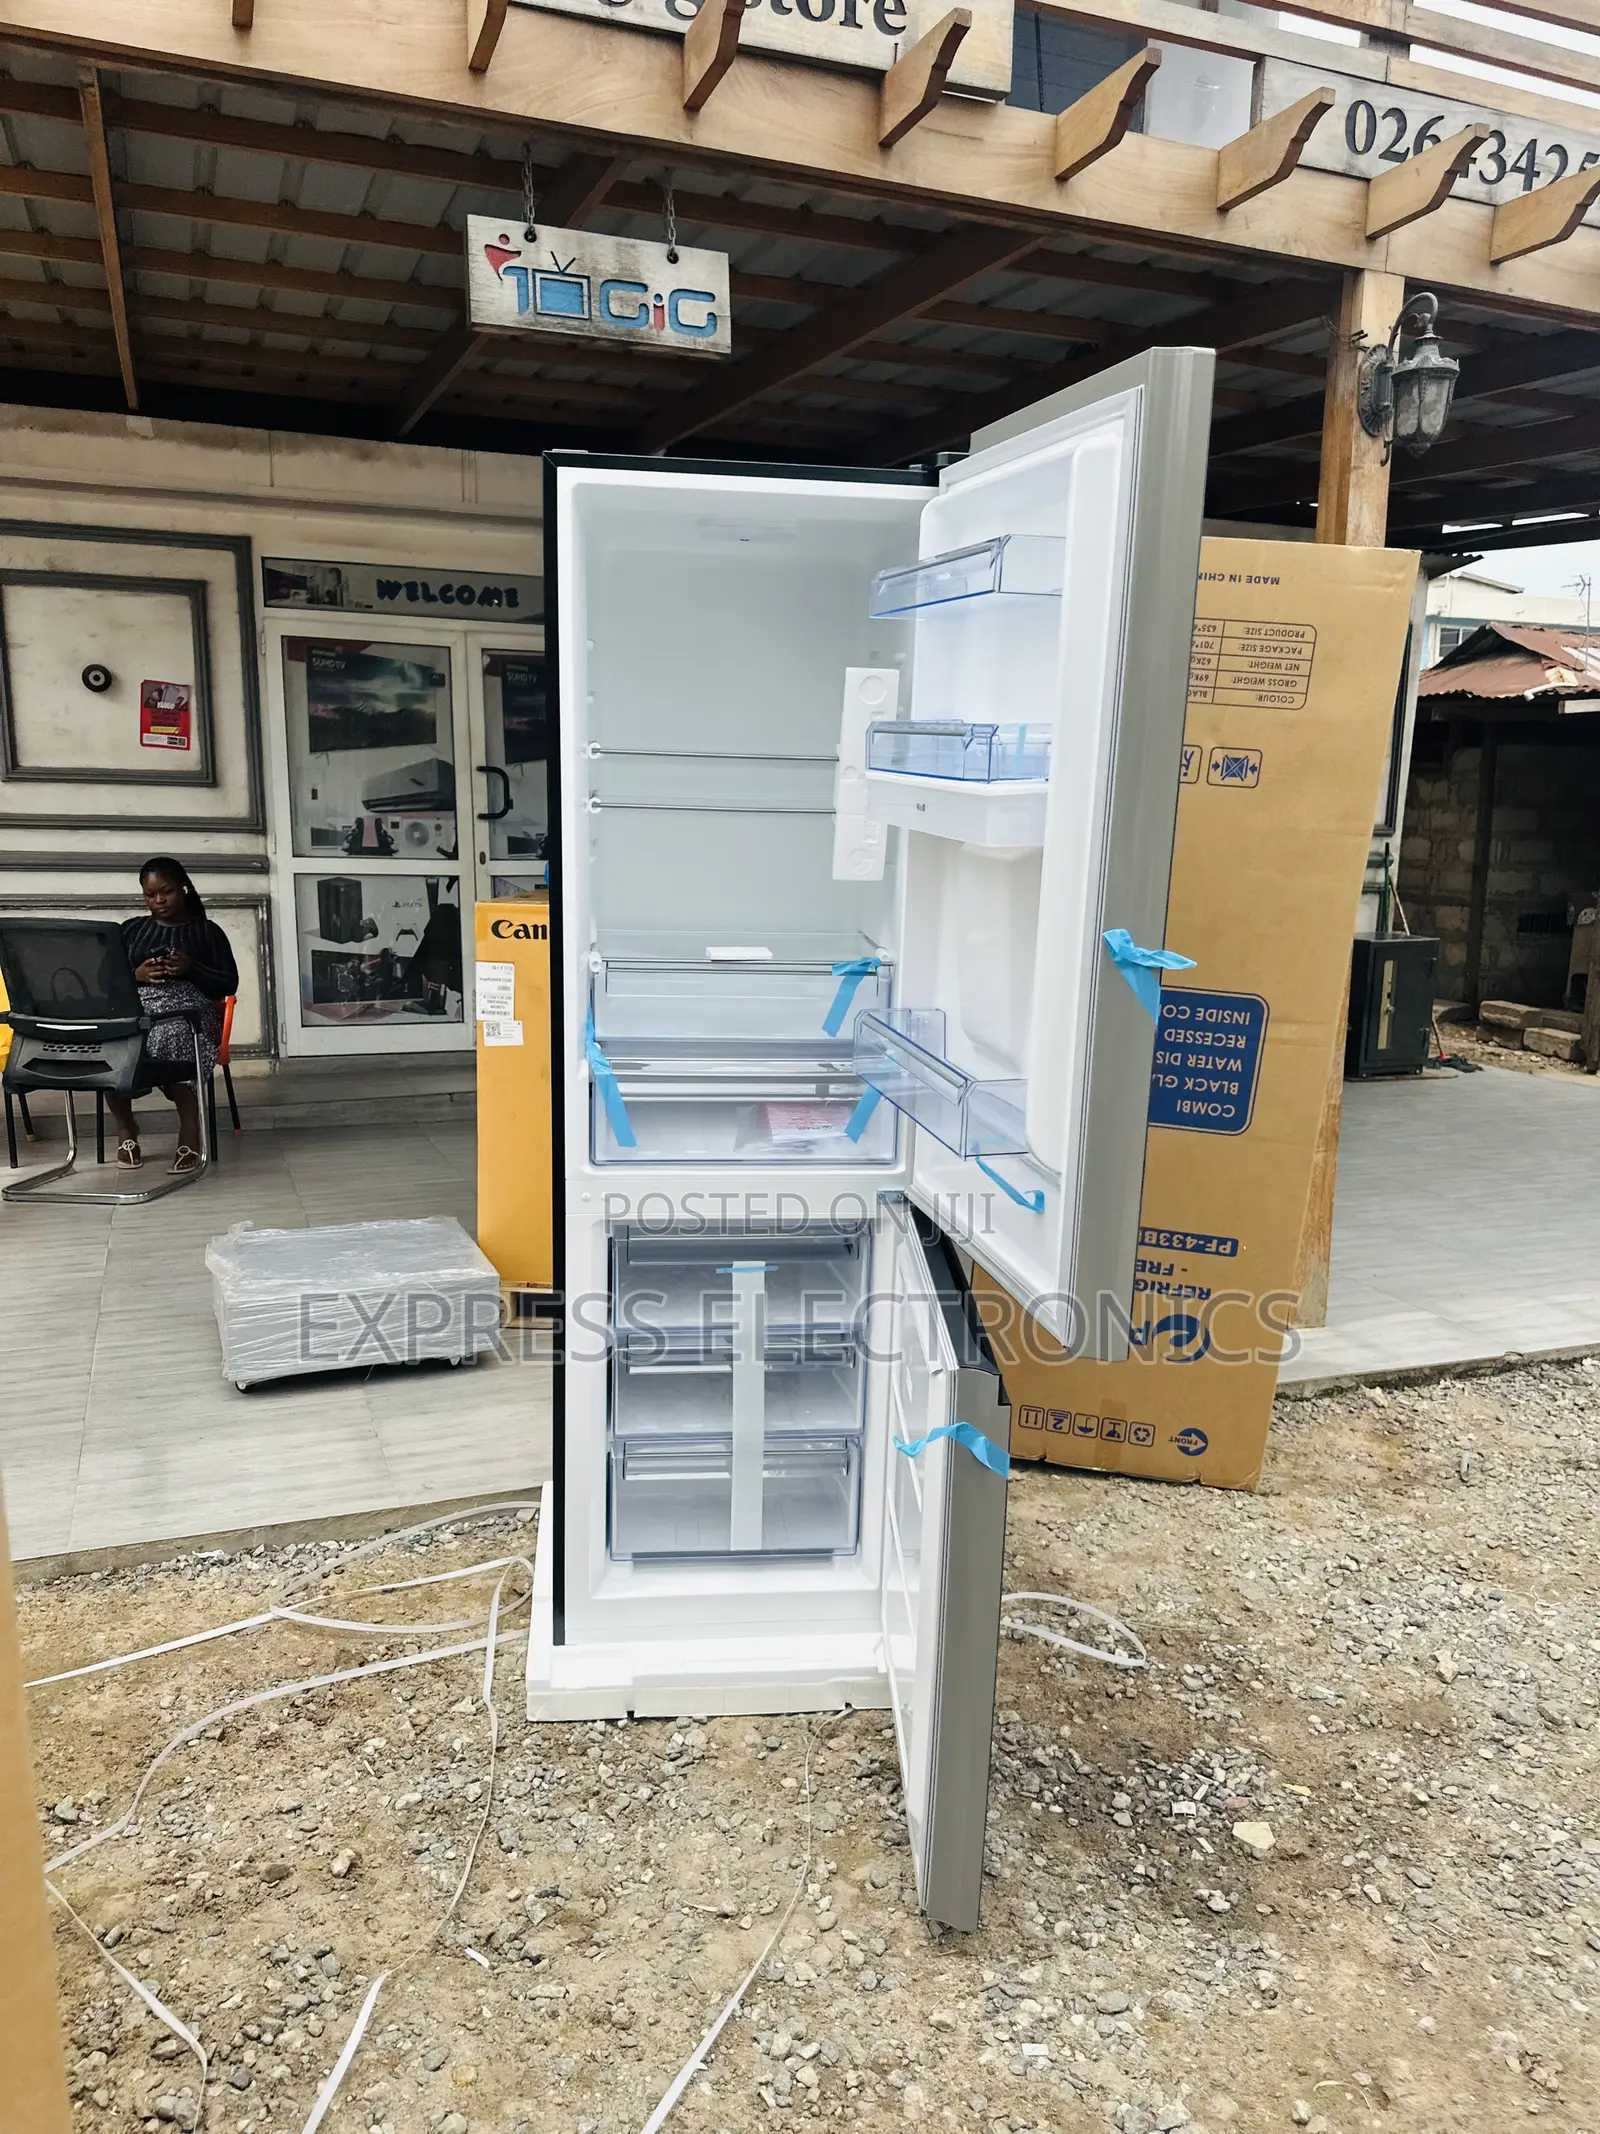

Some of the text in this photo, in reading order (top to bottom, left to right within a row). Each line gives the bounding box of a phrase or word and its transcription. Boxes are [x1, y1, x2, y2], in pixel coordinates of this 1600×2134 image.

[1229, 574, 1241, 583] IN
[1246, 575, 1280, 585] MADE
[376, 578, 520, 608] WELCOME
[1263, 629, 1305, 638] PRODUCT
[1259, 645, 1302, 655] PACKAGE
[1284, 663, 1300, 671] NET
[1267, 678, 1298, 688] GROSS
[1256, 694, 1295, 704] COLOUR:
[1159, 1004, 1251, 1026] INSIDE CO
[1164, 1028, 1247, 1049] RECESSED
[1156, 1051, 1242, 1072] WATER DIS
[1152, 1074, 1240, 1095] BLACK GL
[1176, 1099, 1236, 1118] COMBI
[1138, 1229, 1232, 1254] PF-433B
[1168, 1436, 1198, 1447] FRONT
